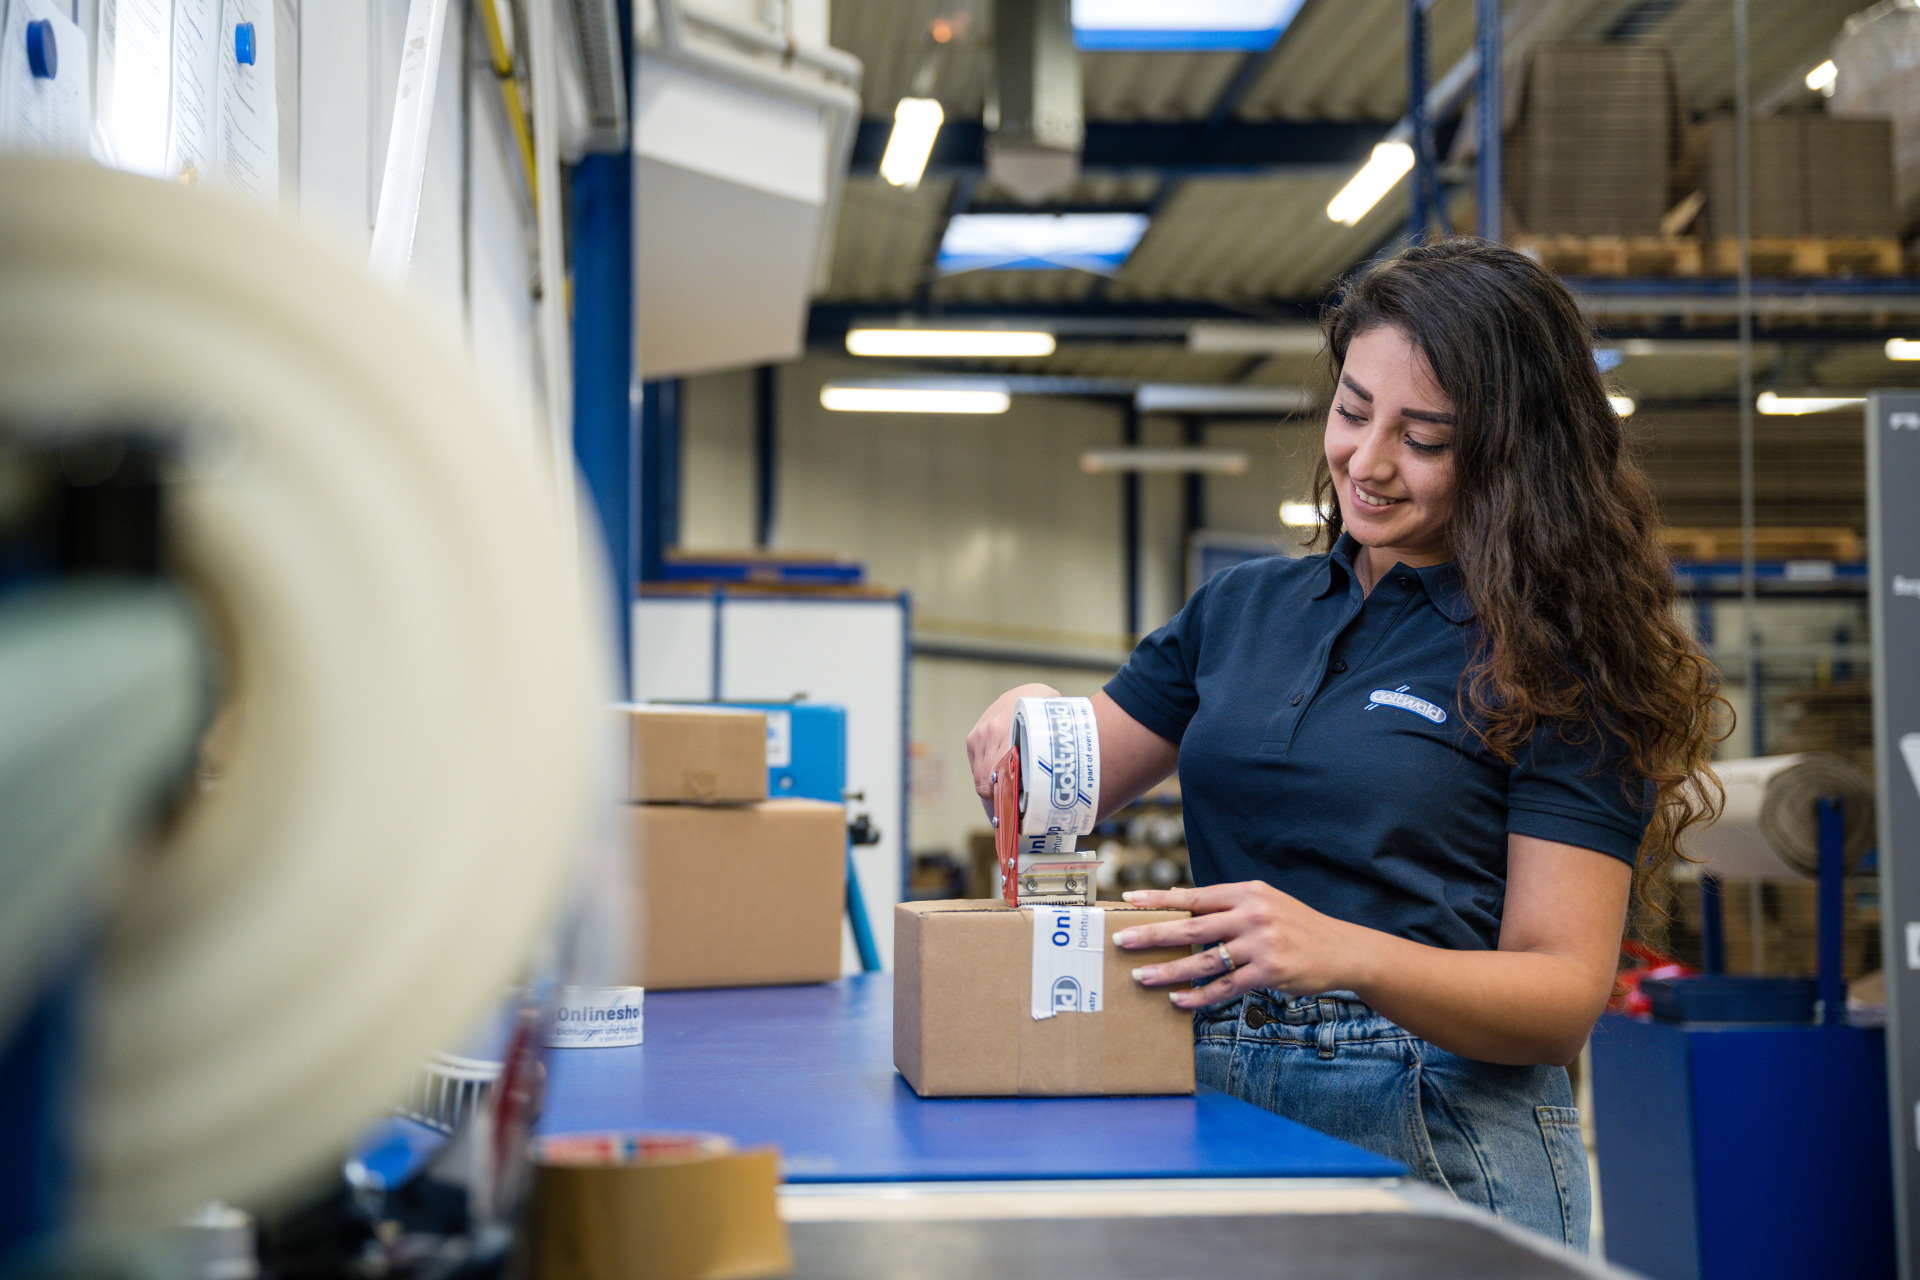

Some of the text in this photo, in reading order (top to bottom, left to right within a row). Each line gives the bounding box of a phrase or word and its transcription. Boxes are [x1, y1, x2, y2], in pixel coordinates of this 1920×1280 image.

[1048, 704, 1076, 807] Gottwald
[1085, 754, 1093, 762] of
[1086, 764, 1095, 781] part
